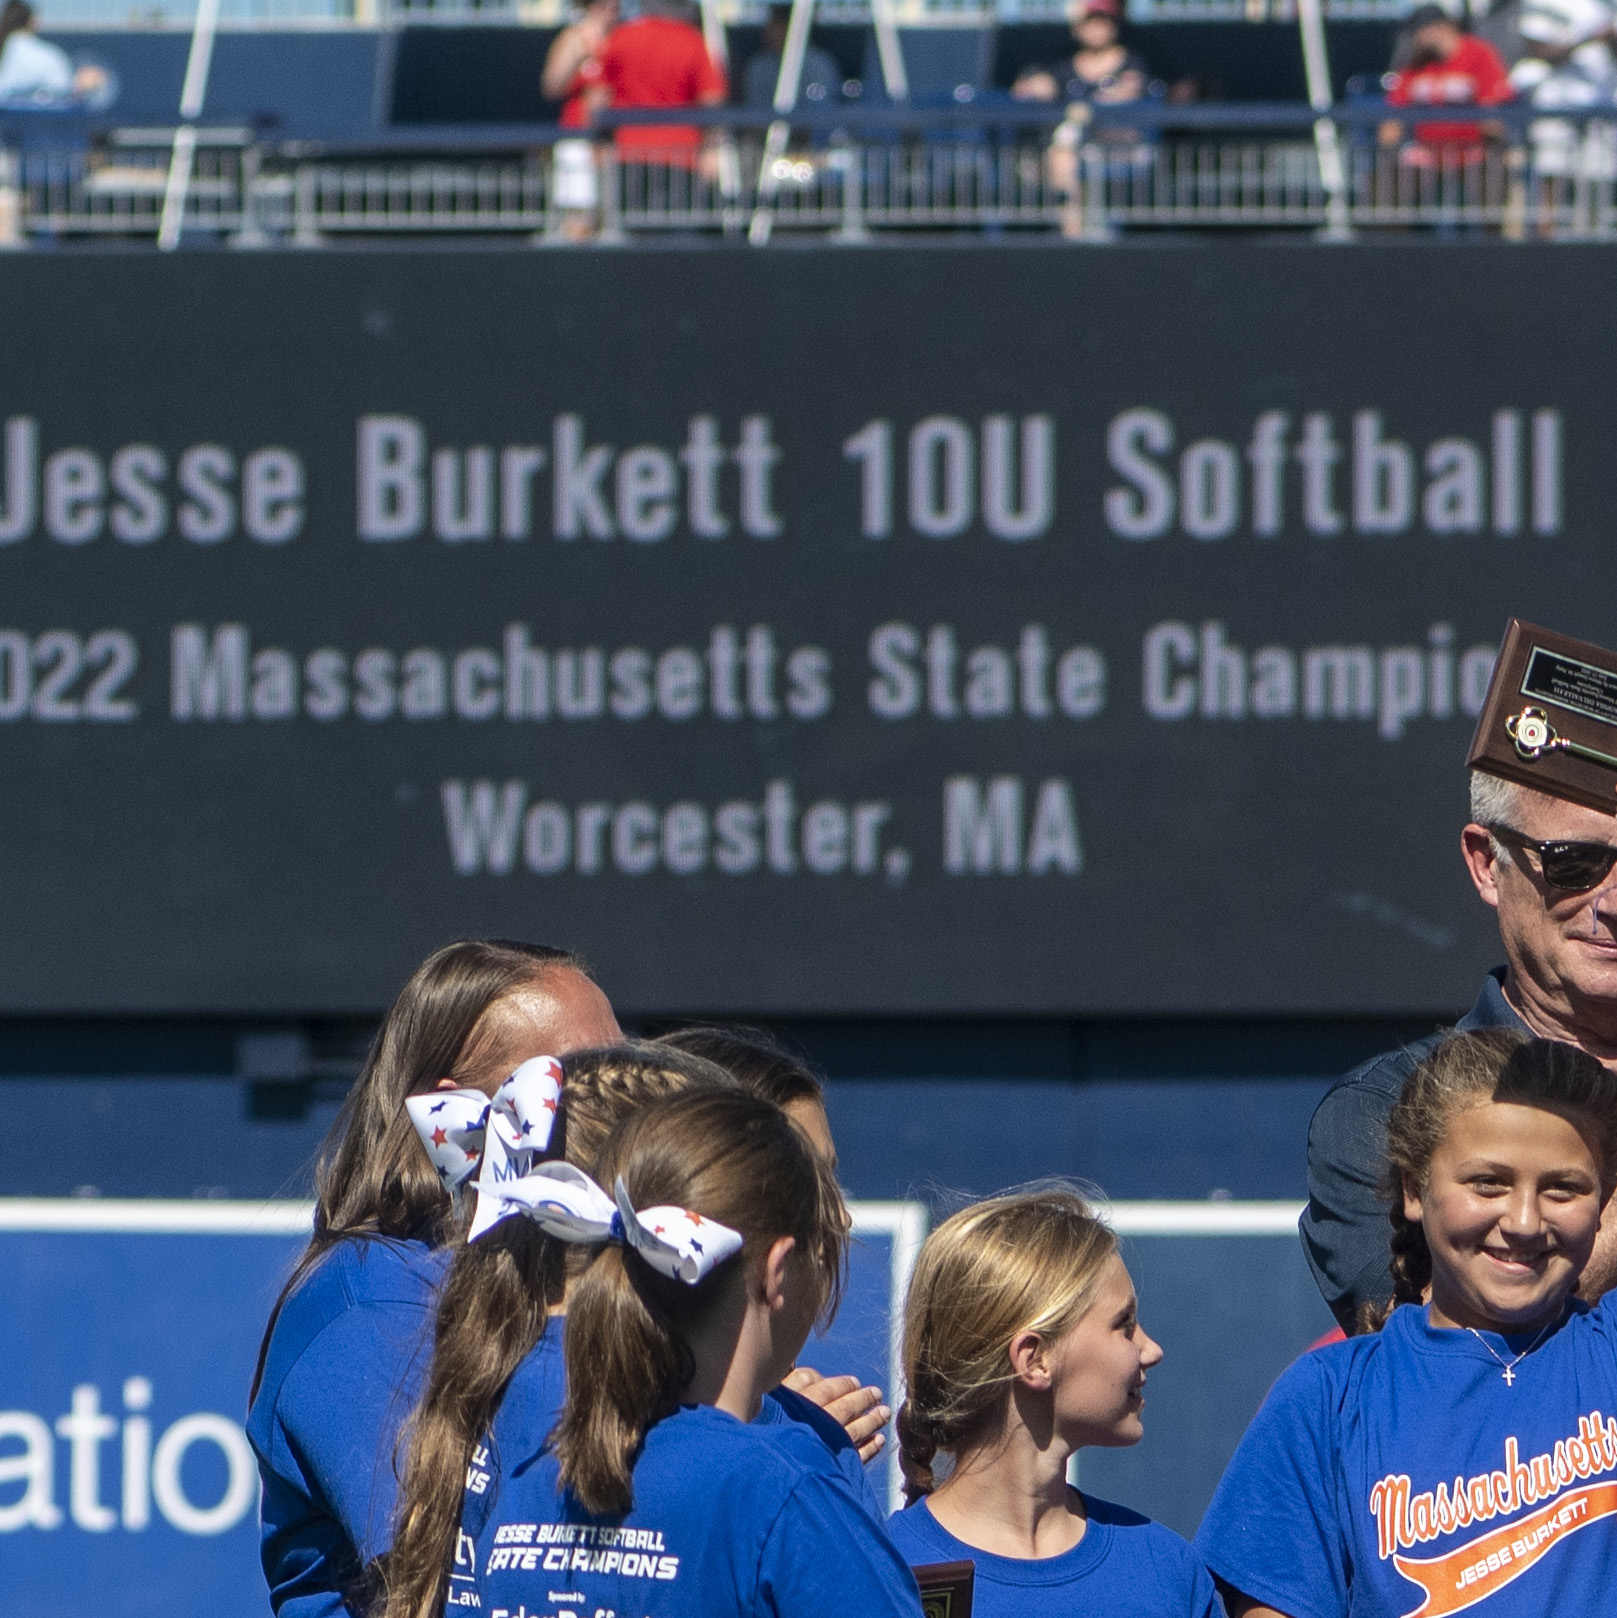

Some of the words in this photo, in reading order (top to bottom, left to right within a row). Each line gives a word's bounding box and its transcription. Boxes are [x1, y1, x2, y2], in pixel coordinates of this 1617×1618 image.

[0, 415, 304, 545] Jesse
[357, 413, 780, 542] Burkett
[845, 414, 1056, 541] 10U
[1103, 408, 1562, 540] Softball
[170, 622, 832, 721] Massachusetts
[868, 622, 1107, 720] State
[1143, 619, 1500, 740] Champio
[441, 778, 909, 881] Worcester,
[942, 776, 1084, 876] MA
[1455, 1545, 1513, 1590] JESSE
[1511, 1497, 1589, 1557] BURKETT
